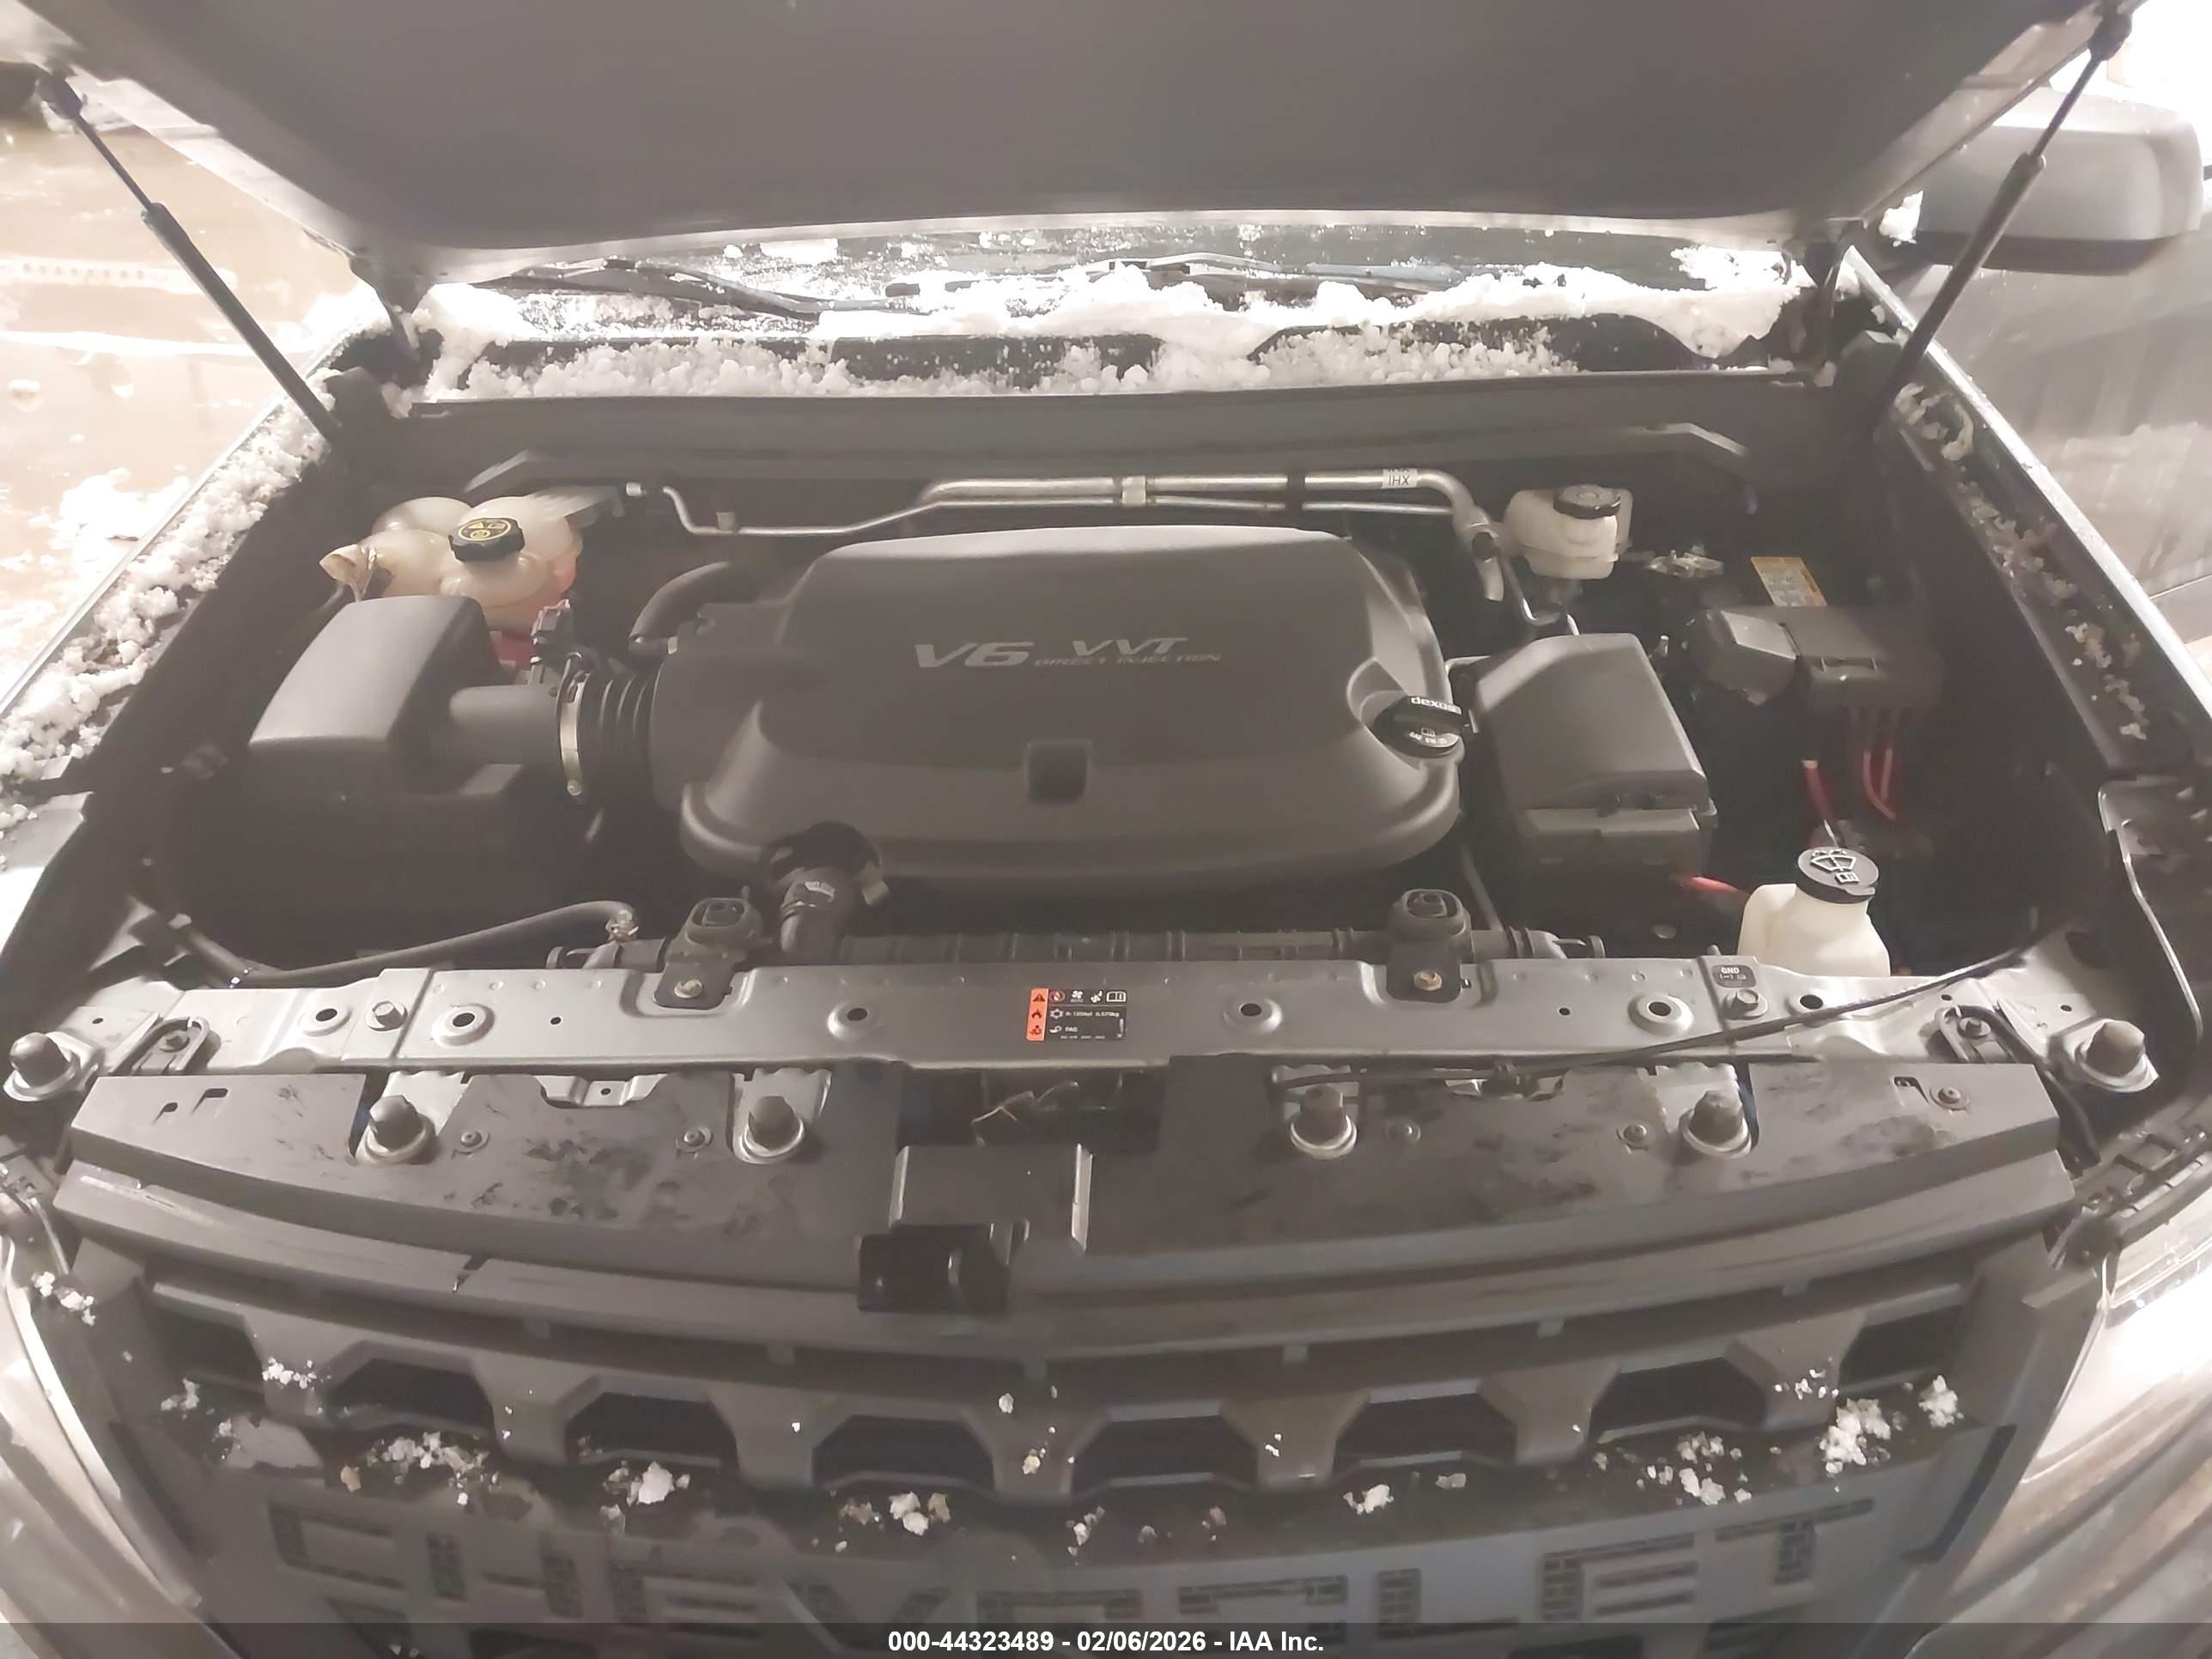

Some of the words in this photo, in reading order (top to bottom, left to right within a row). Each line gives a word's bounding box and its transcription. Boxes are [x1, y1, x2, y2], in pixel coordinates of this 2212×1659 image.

[1389, 474, 1410, 485] IHX
[915, 641, 1036, 669] V6
[1072, 637, 1189, 657] VVT
[1033, 657, 1107, 667] DIRECT
[1116, 653, 1223, 666] INJECTION
[268, 1497, 1880, 1652] CHEVROLET
